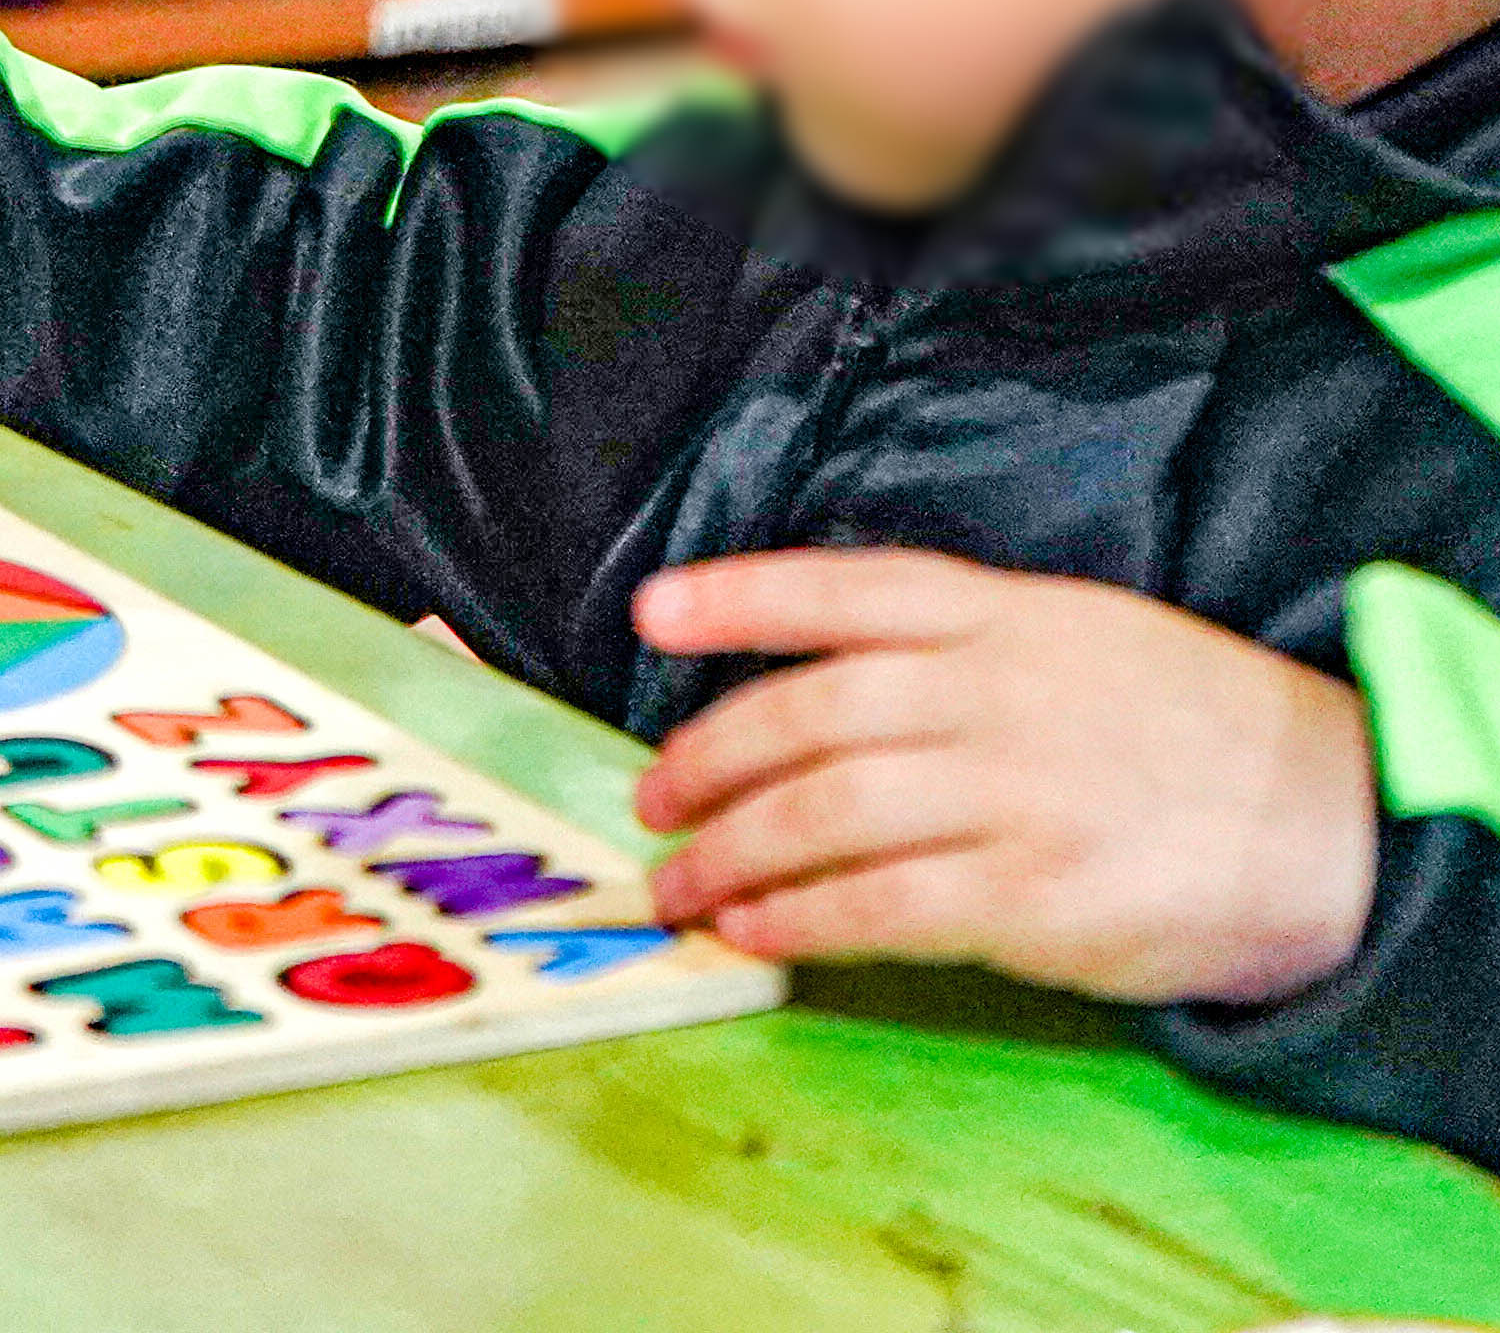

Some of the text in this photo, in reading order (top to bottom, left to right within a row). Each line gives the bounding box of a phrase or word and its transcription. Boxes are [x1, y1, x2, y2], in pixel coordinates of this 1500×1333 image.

[0, 797, 196, 844] T
[109, 693, 675, 985] V W X Y Z
[92, 838, 294, 892] S
[177, 884, 390, 953] R
[25, 958, 266, 1039] M
[275, 935, 482, 1012] Q
